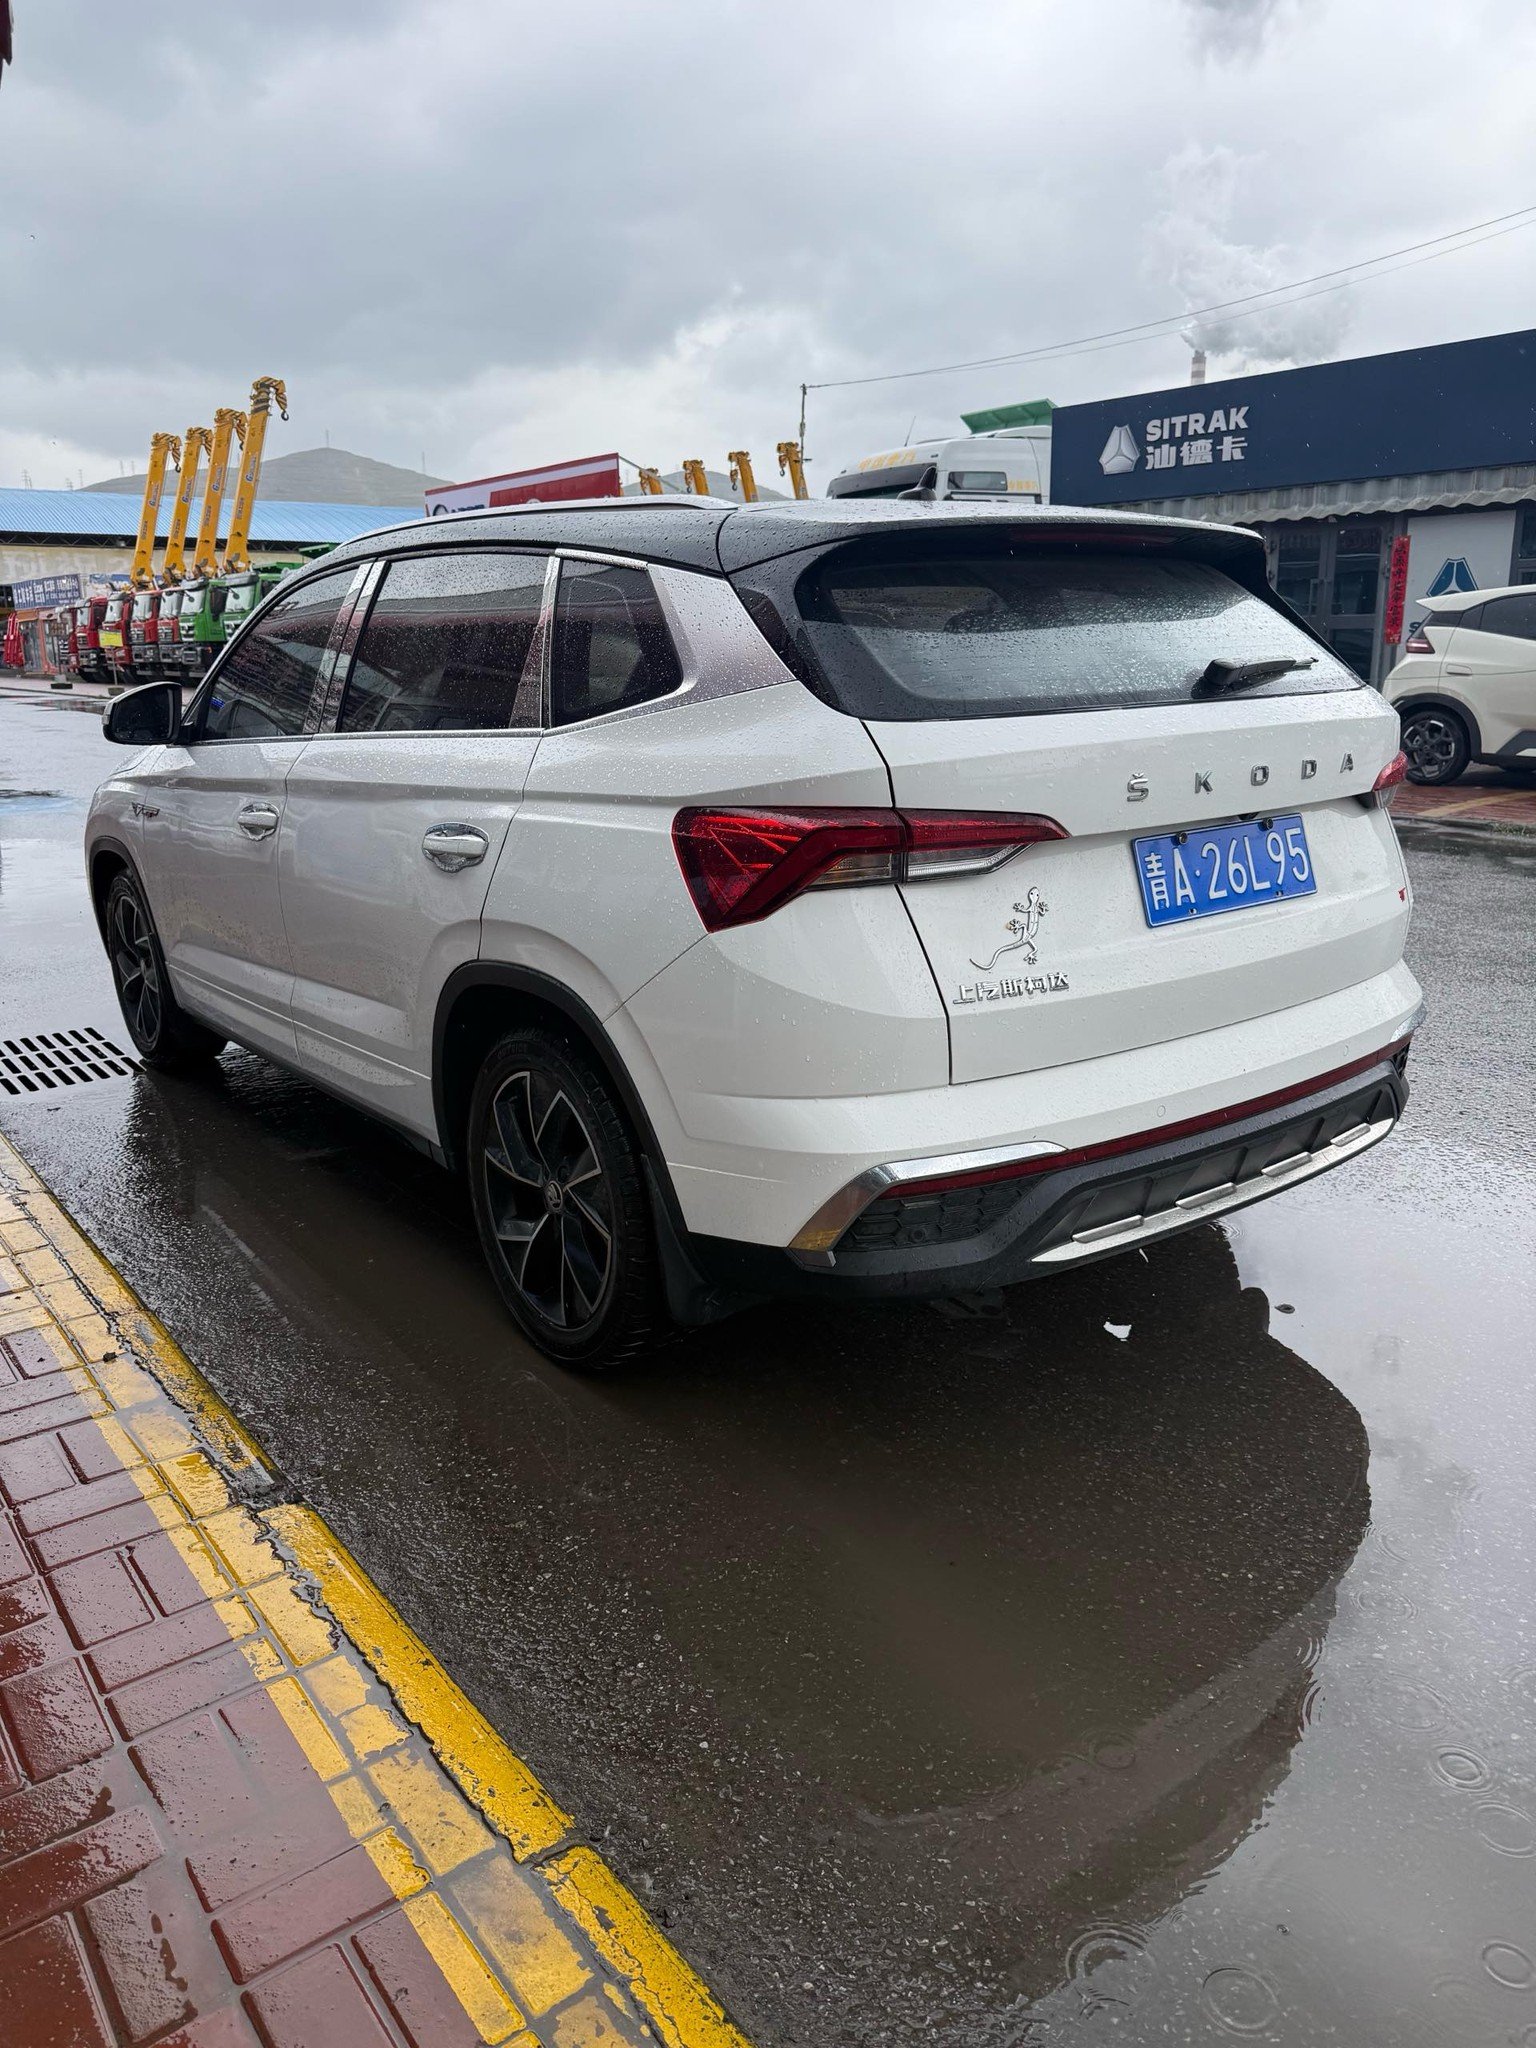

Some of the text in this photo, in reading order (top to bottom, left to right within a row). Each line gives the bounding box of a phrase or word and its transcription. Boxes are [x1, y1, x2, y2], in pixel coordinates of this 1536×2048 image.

[1146, 406, 1250, 442] SITRAK
[1145, 436, 1248, 470] 汕德卡
[1126, 752, 1354, 802] ŠKODA
[953, 972, 1070, 1005] 上汽斯柯达
